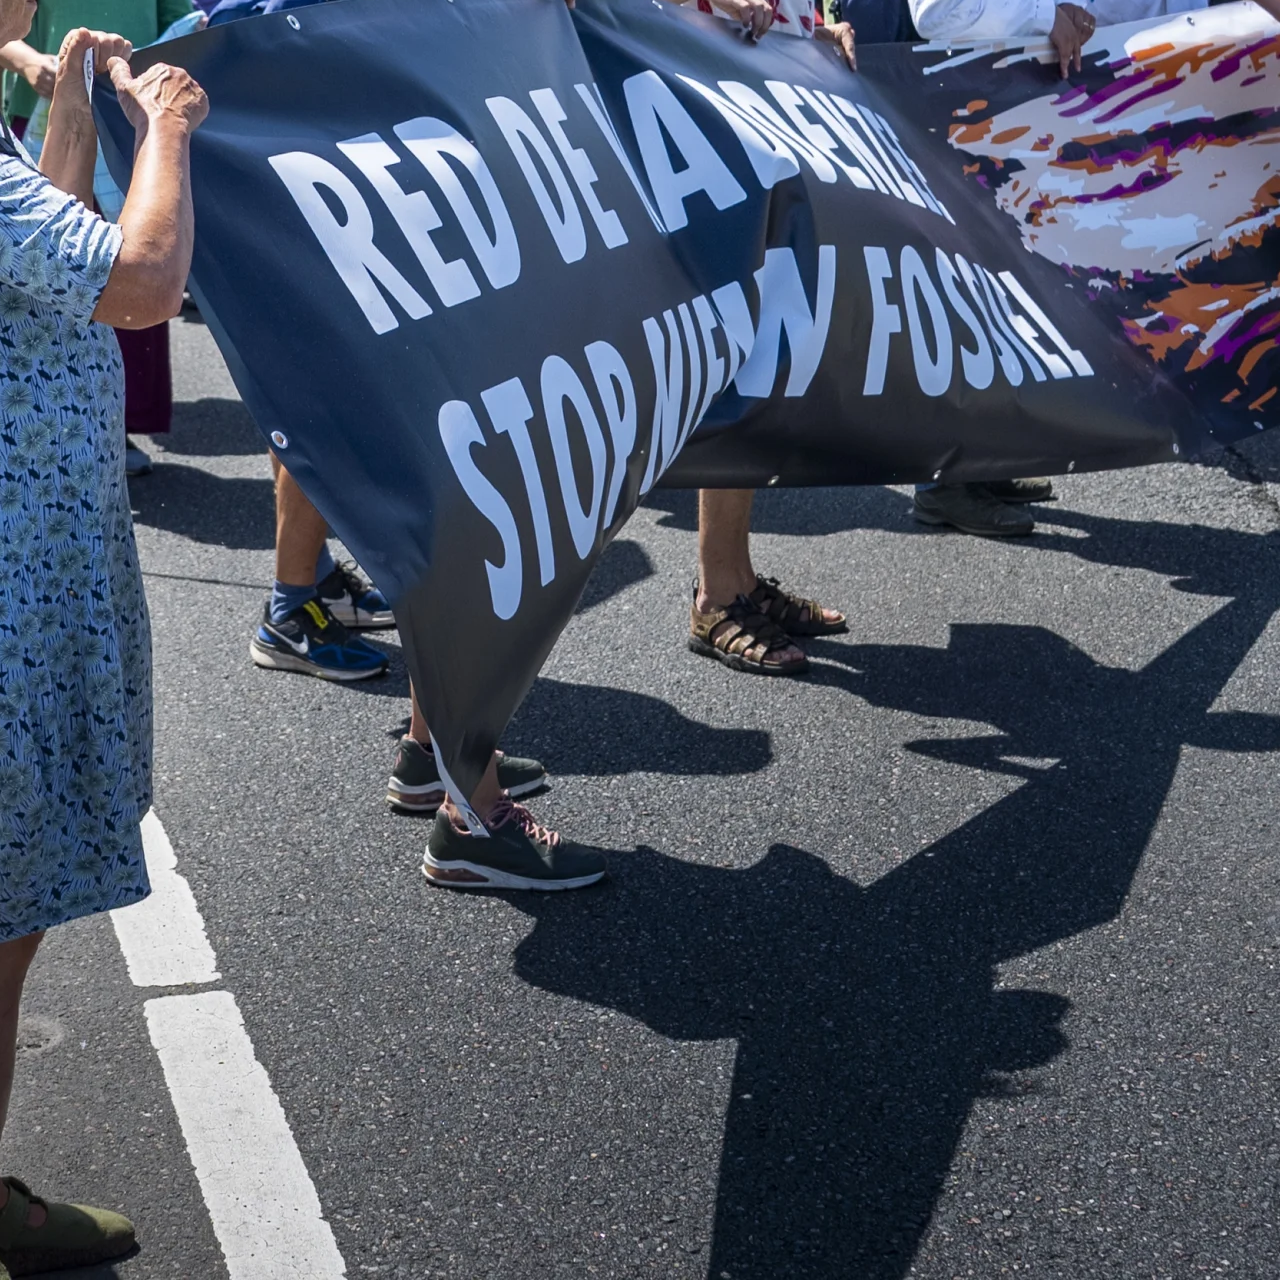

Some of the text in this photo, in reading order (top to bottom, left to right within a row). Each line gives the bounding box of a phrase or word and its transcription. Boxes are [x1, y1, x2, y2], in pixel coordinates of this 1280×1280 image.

[268, 116, 522, 335] RED
[485, 88, 629, 266] DE
[438, 340, 637, 620] STOP
[863, 244, 1095, 397] FOSSIEL
